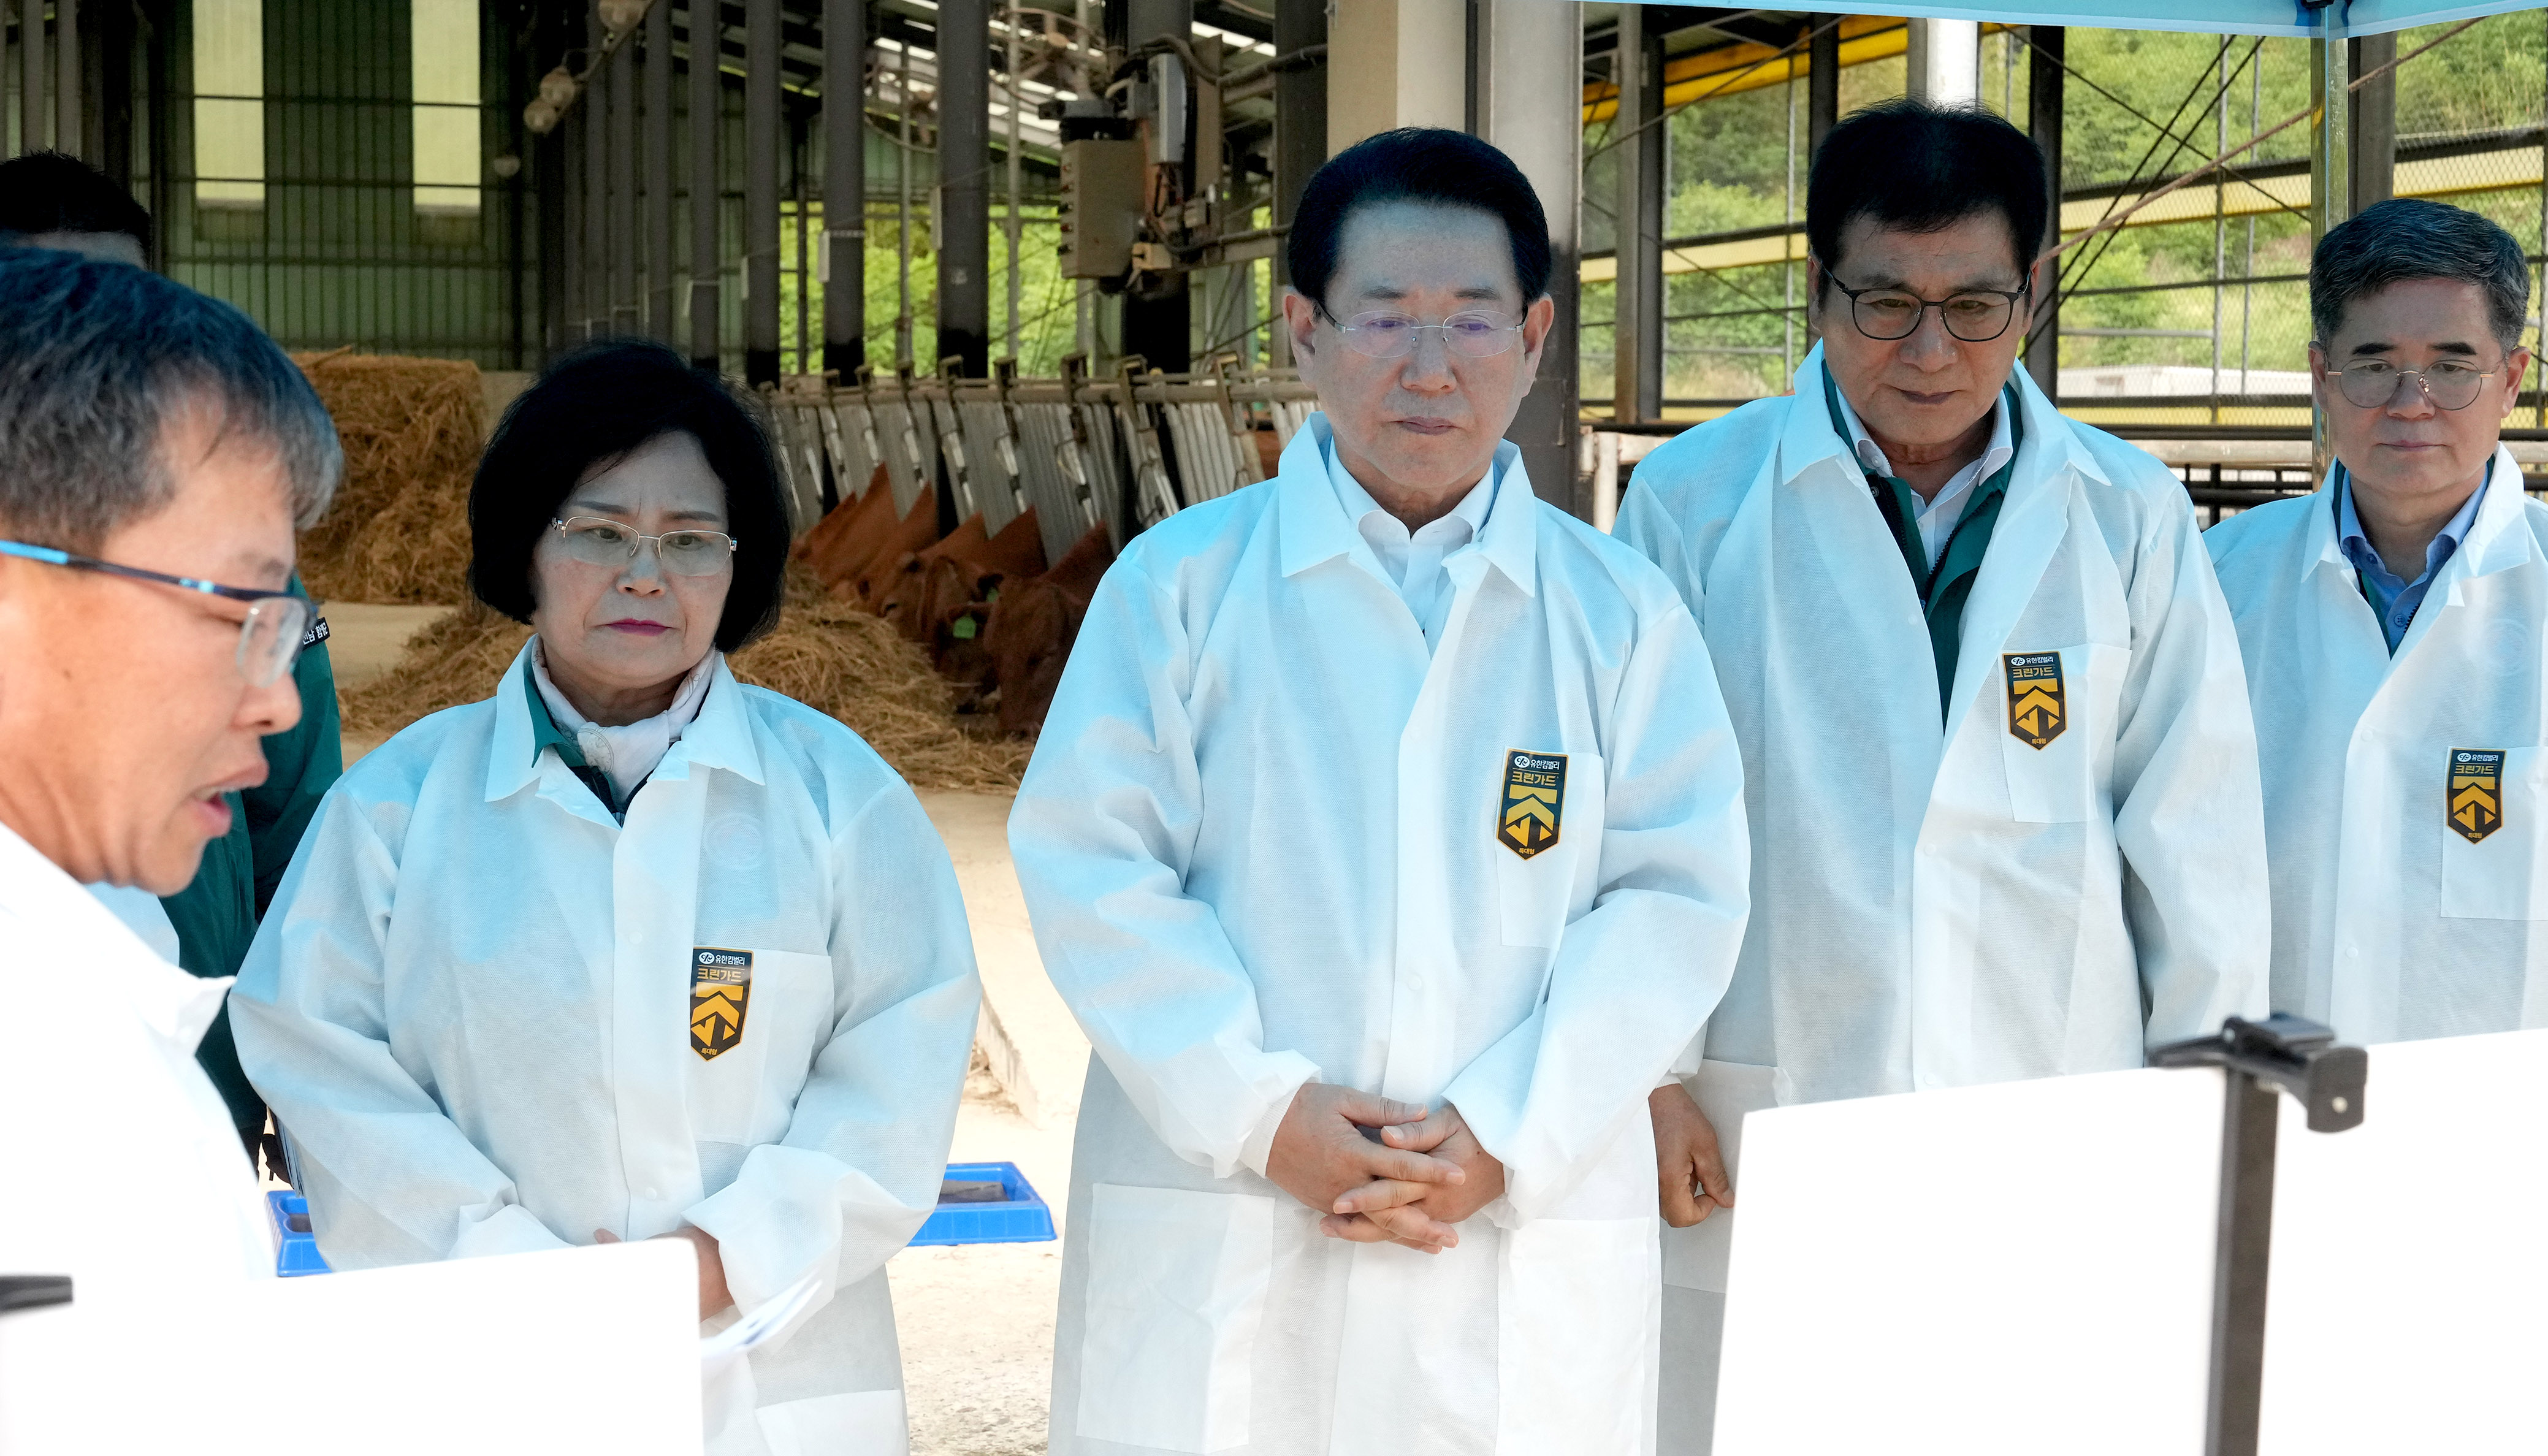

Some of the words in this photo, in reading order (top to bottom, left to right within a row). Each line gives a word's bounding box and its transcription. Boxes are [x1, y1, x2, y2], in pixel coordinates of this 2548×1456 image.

[2013, 666, 2055, 678] 크린가드
[1530, 759, 1560, 770] 유한킴벌리
[2454, 765, 2494, 774] 크린가드
[1511, 771, 1557, 787] 크린가드
[715, 955, 746, 966] 유한킴벌리
[696, 967, 742, 983] 크린가드
